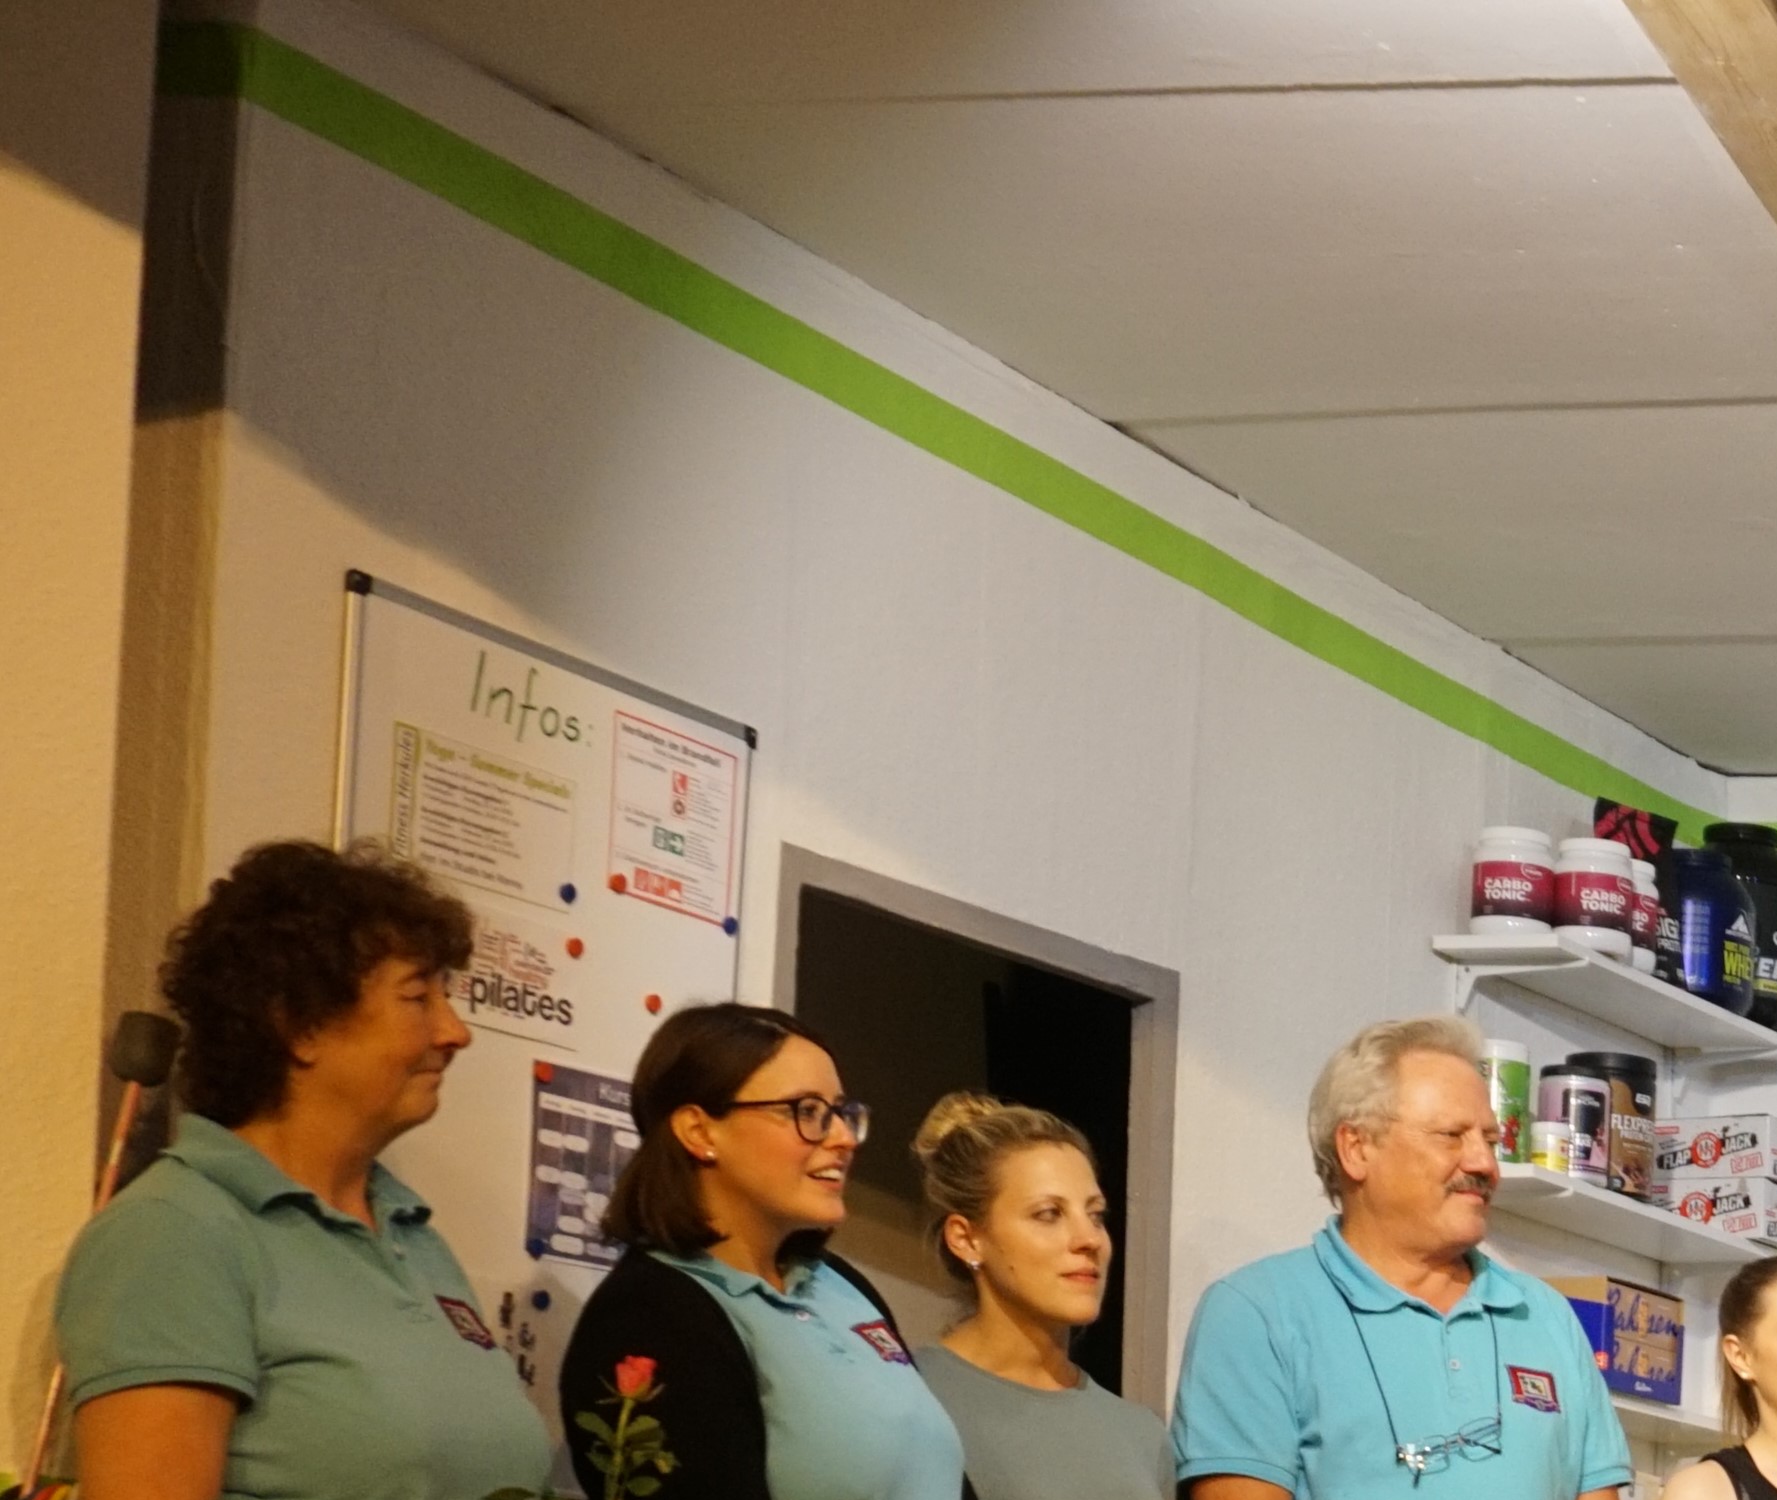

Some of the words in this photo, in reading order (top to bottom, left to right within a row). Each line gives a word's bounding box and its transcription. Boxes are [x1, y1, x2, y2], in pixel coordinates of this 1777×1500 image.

[1484, 877, 1533, 892] CARBO
[1484, 888, 1528, 902] TONIC
[1580, 888, 1627, 906] CARBO
[1580, 900, 1623, 915] TONIC
[470, 971, 574, 1026] pilates
[1663, 1150, 1692, 1169] FLAP
[1722, 1132, 1752, 1154] JACK
[1714, 1194, 1745, 1216] JACK
